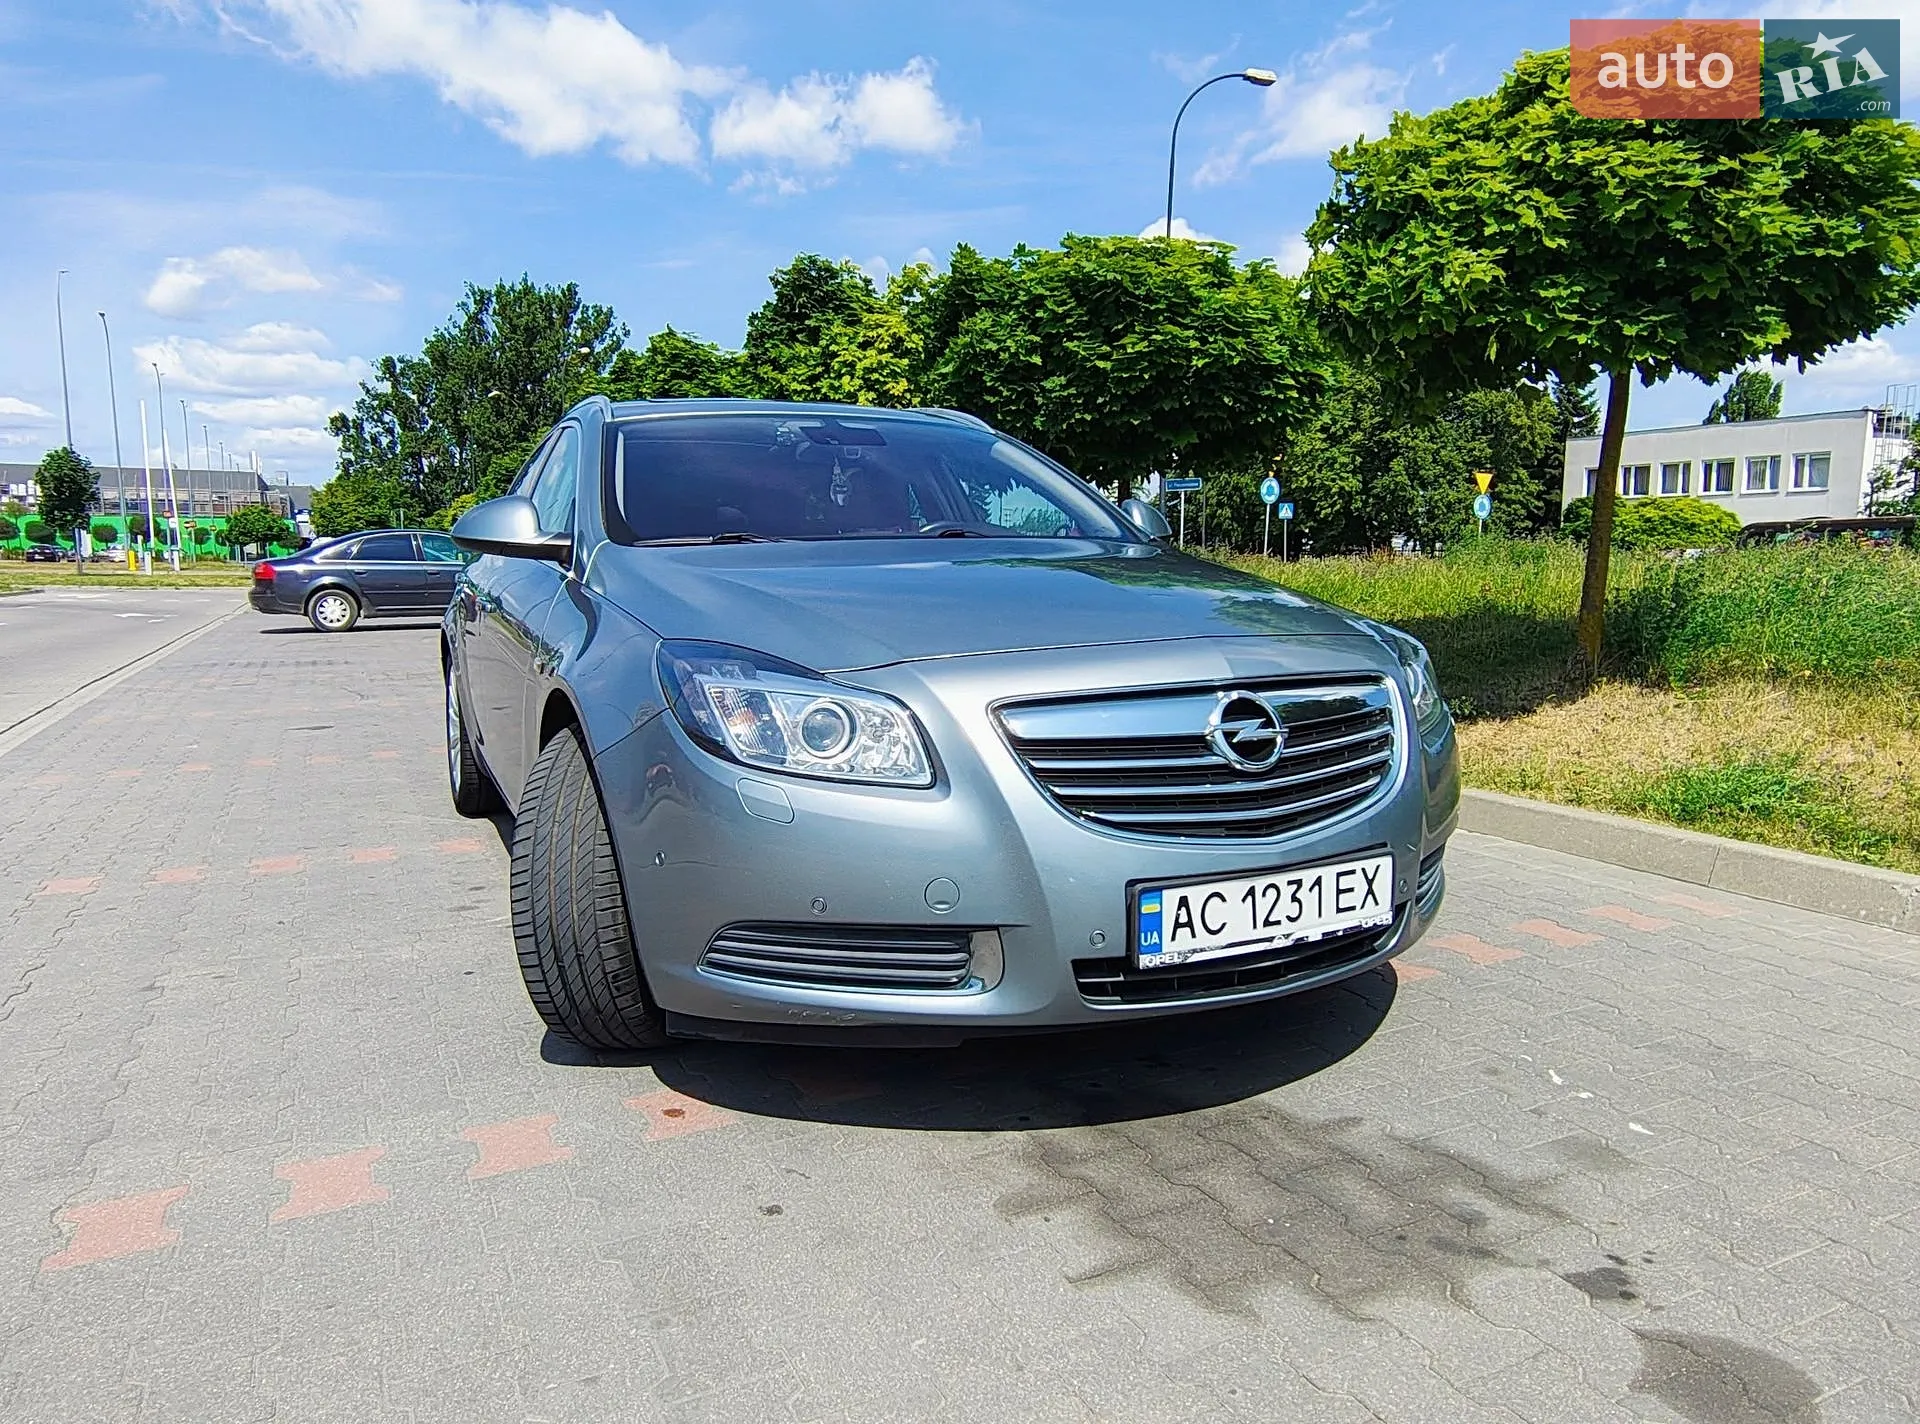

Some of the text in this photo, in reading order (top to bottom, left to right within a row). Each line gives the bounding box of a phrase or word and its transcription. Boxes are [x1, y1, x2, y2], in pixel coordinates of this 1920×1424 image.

[1170, 864, 1382, 942] AC 1231 EX
[1141, 930, 1160, 946] UA
